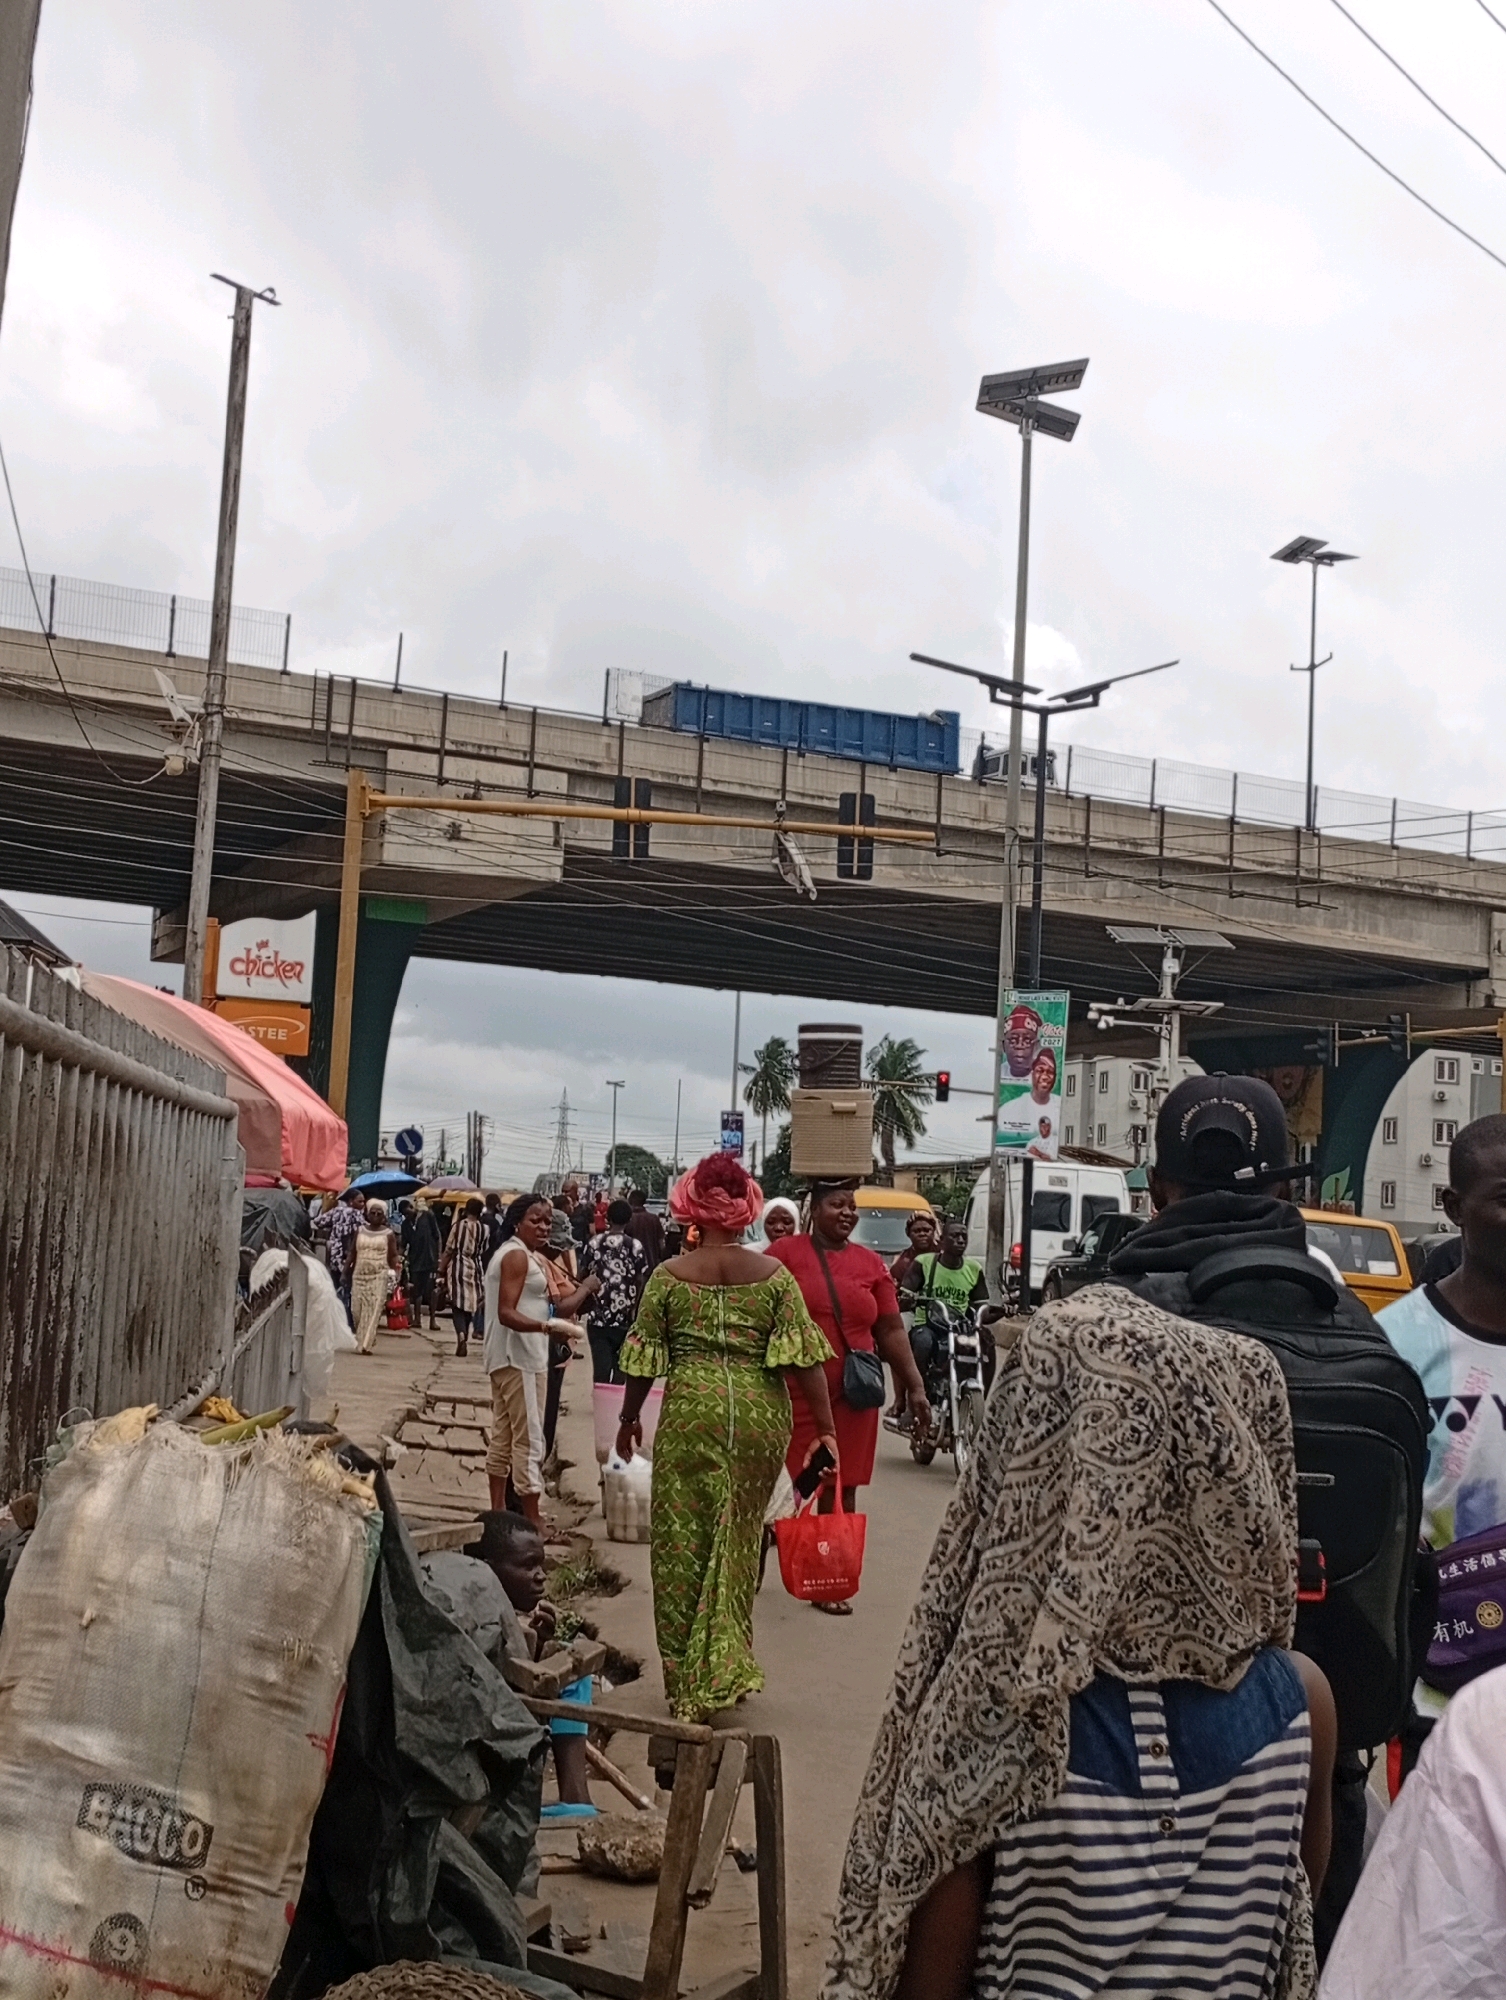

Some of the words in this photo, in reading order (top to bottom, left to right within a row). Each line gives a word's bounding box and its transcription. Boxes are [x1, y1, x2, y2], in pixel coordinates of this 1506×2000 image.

[229, 947, 305, 989] chicken
[1432, 1618, 1474, 1643] 有机
[86, 1790, 205, 1860] BAGCO
